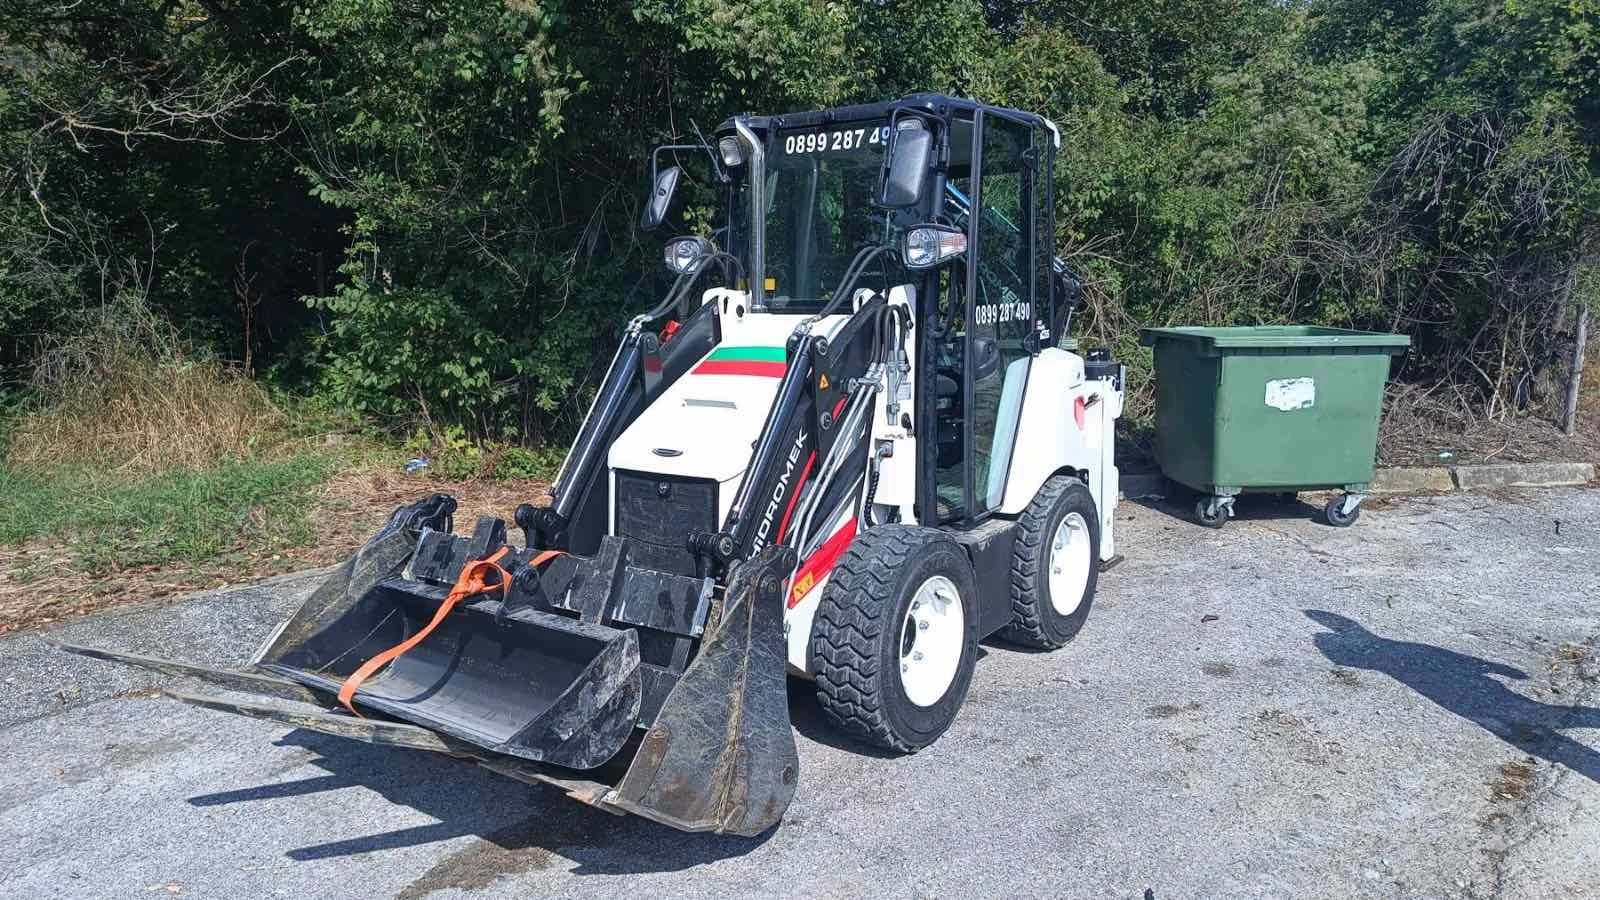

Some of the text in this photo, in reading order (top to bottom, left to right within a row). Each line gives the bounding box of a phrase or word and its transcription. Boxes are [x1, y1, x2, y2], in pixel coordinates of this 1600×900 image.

[784, 126, 891, 154] 0899 287 49
[975, 302, 1031, 325] 0899 287 490
